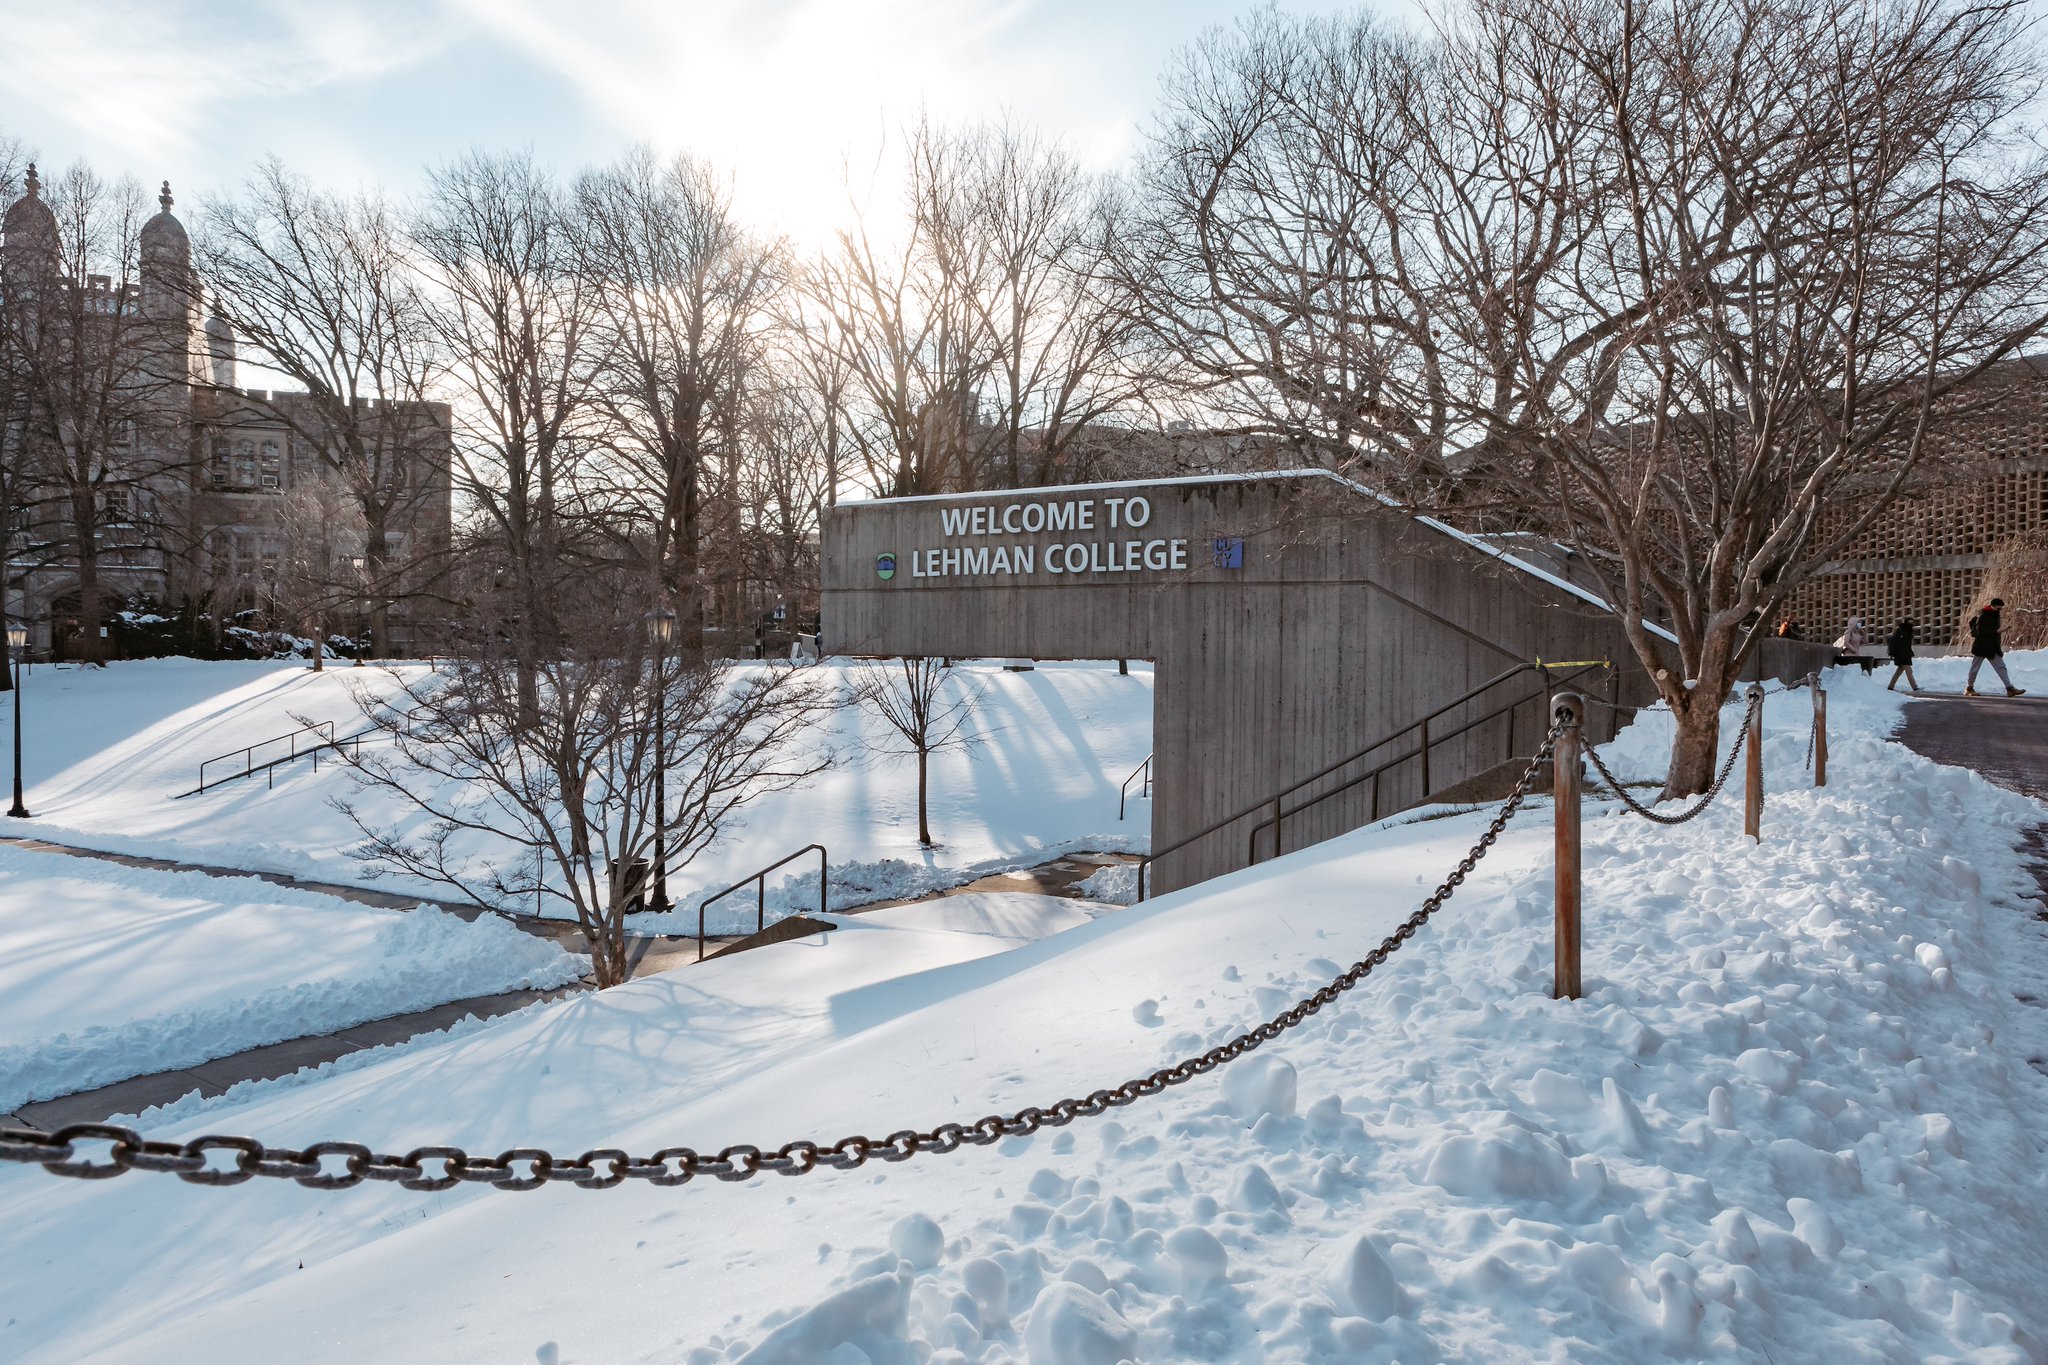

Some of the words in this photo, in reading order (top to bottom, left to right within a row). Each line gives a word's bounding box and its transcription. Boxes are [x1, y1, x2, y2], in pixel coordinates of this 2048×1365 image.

[941, 500, 1094, 536] WELCOME
[1105, 497, 1150, 528] TO
[912, 545, 1034, 577] LEHMAN
[1044, 539, 1187, 574] COLLEGE
